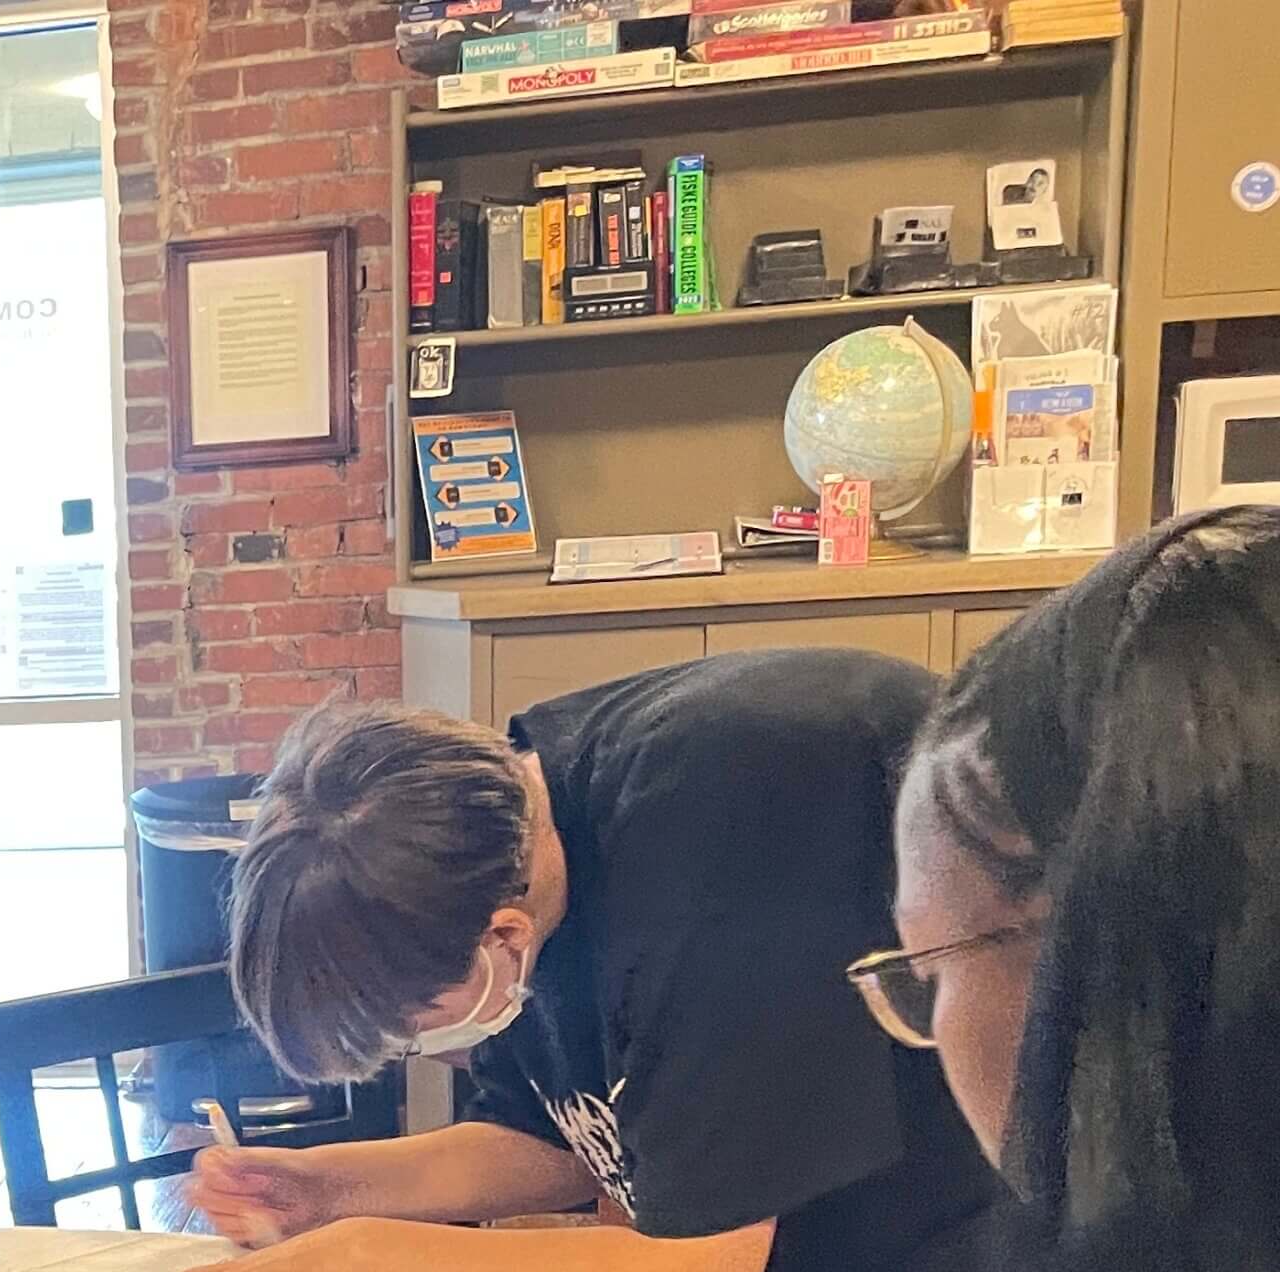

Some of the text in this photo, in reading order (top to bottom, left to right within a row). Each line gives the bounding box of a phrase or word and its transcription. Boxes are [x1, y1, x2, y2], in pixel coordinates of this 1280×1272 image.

[465, 42, 517, 58] NARWHAL
[509, 68, 596, 94] MONOPOLY
[680, 173, 698, 295] FISKE GUIDE COLLEGES
